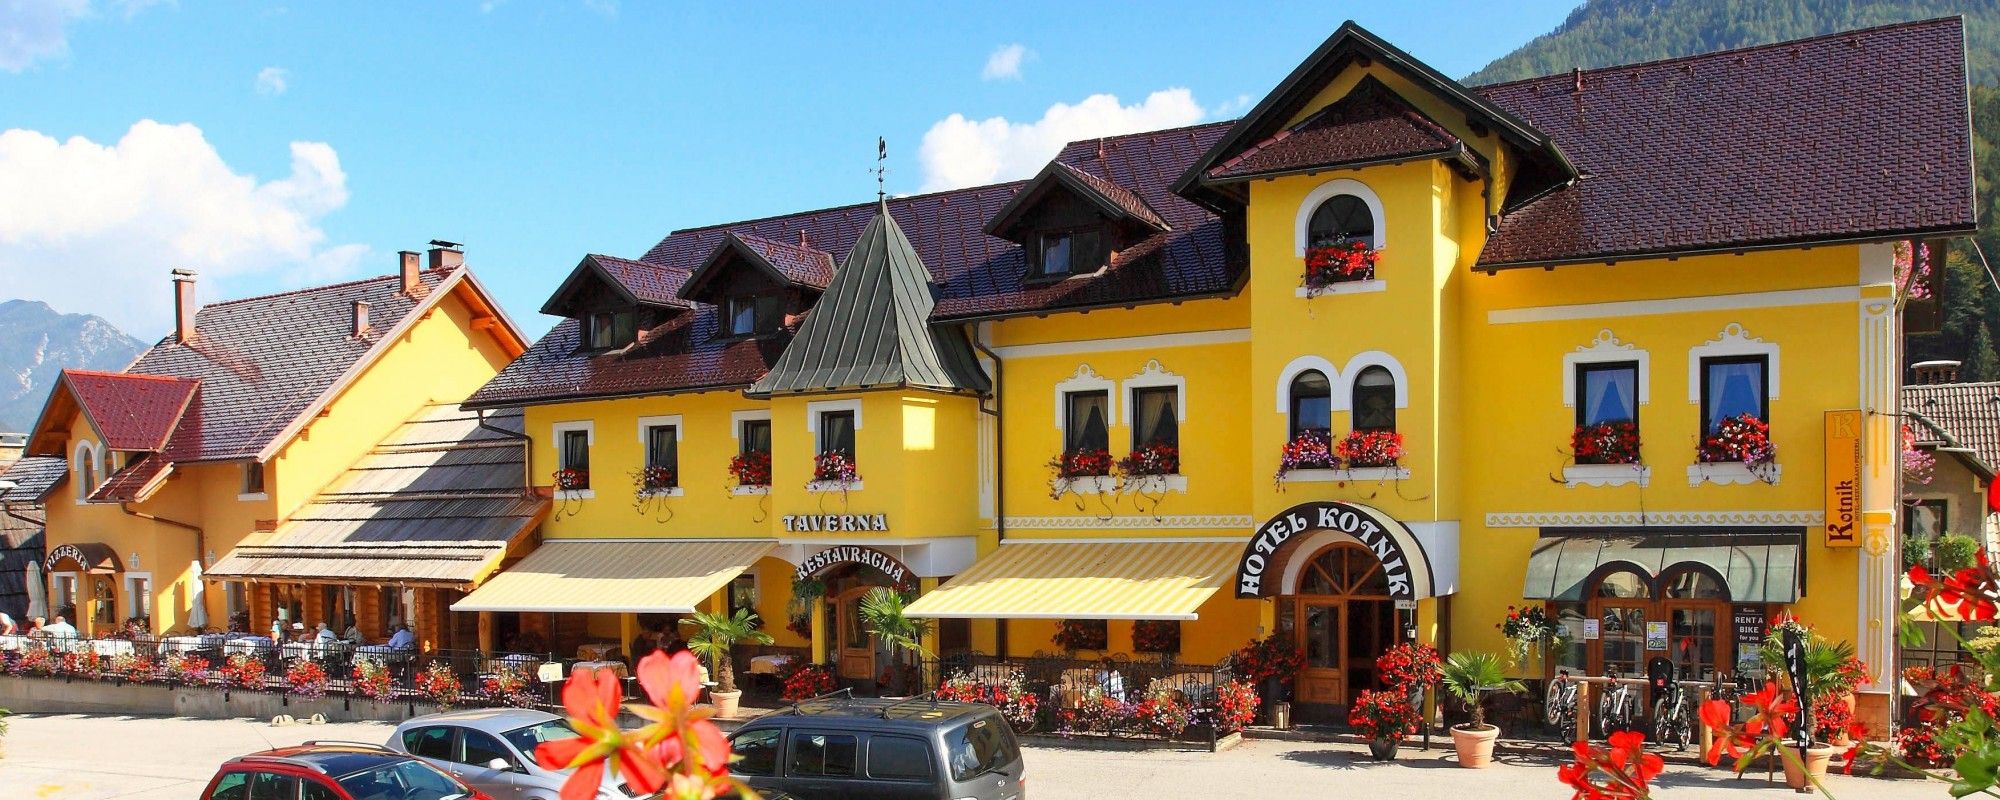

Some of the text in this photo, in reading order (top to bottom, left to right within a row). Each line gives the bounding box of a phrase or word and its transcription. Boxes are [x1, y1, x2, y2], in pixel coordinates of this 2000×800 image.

[783, 514, 889, 532] TAVERNA
[1828, 480, 1853, 542] Kotnik
[46, 546, 87, 571] PIZZERIA
[796, 546, 905, 582] RESTAVRACIJA
[1240, 507, 1410, 596] HOTEL KOTNIK
